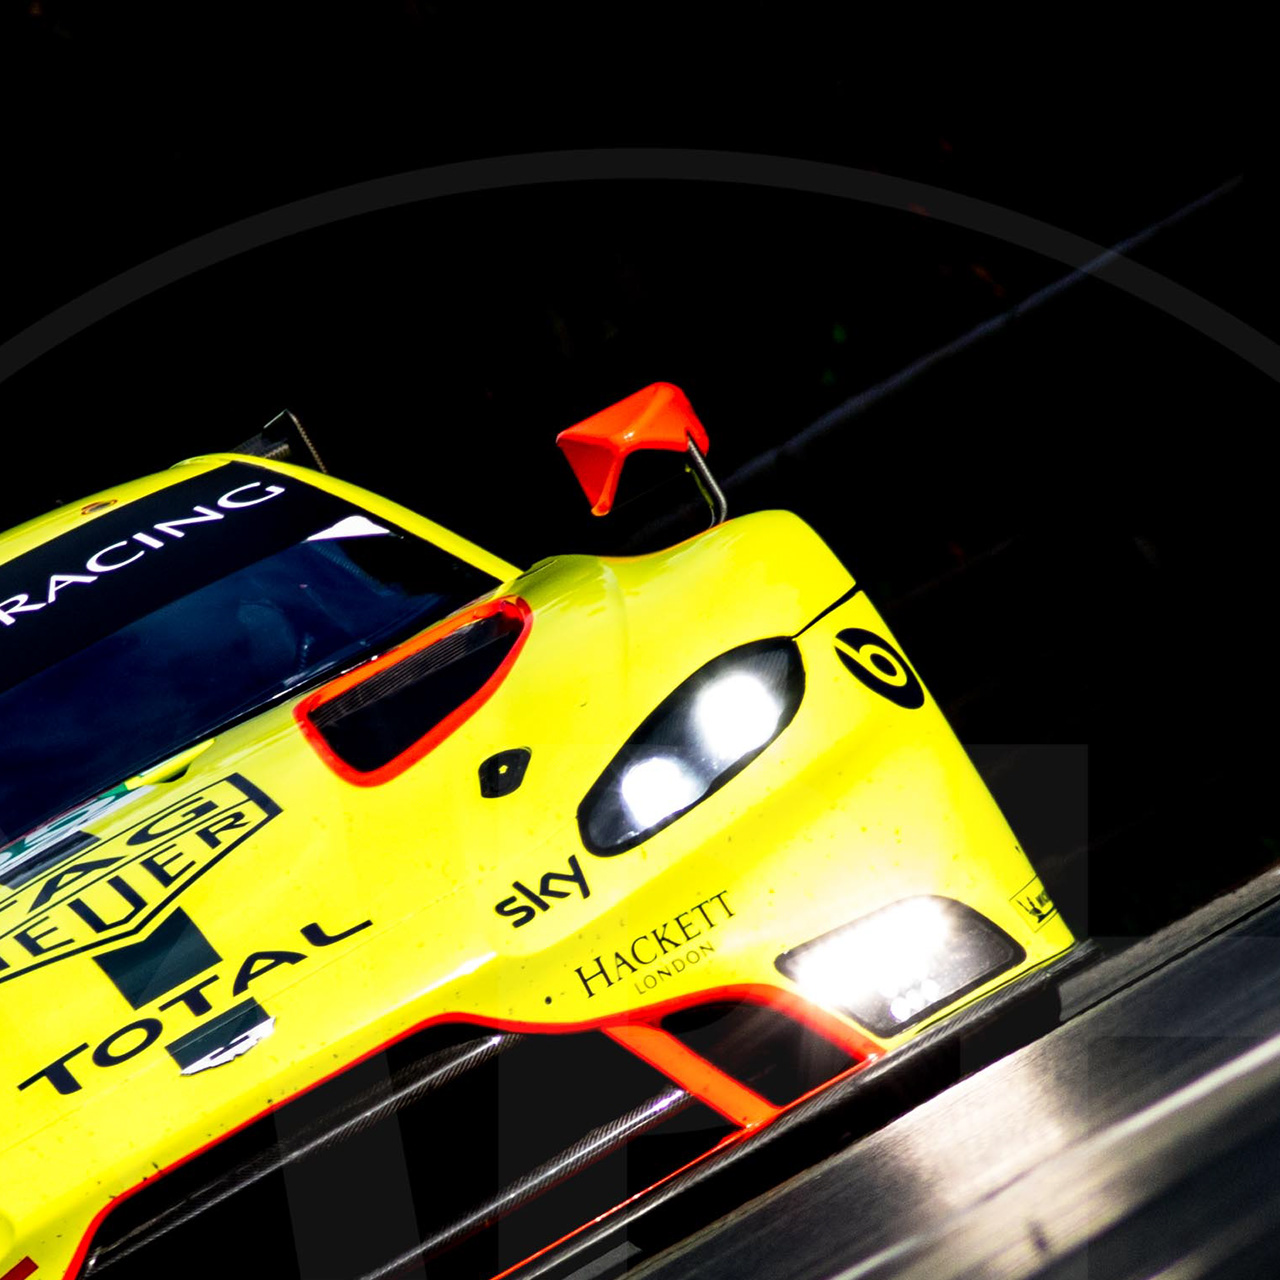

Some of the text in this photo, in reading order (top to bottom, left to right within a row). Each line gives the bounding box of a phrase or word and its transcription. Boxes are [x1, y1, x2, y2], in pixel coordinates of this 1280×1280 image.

[496, 856, 590, 927] sky
[575, 891, 734, 998] HACKETT
[635, 943, 715, 995] LONDON
[17, 919, 373, 1095] TOTAL
